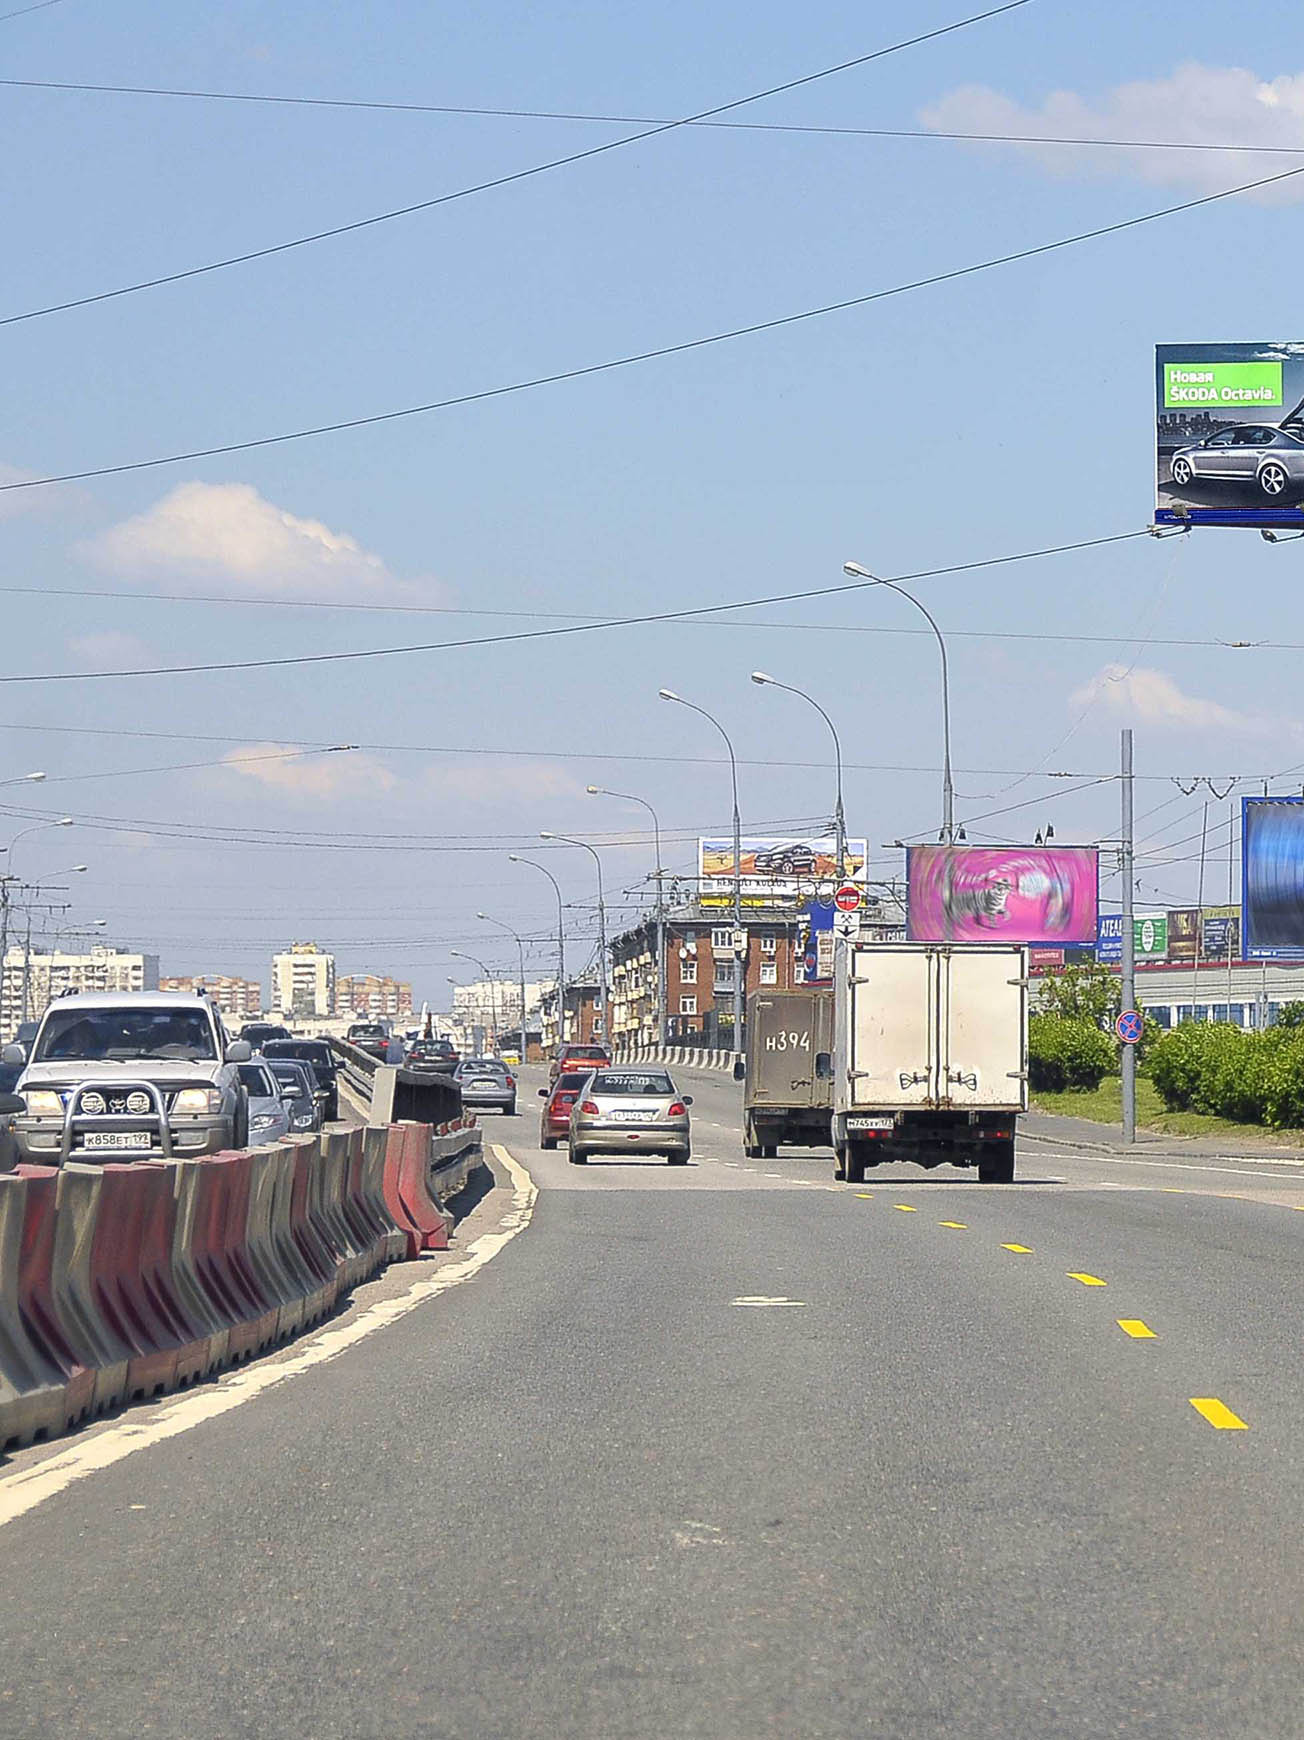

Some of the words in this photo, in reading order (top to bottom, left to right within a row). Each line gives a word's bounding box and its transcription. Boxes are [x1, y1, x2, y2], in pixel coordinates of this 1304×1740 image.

[1169, 369, 1214, 384] Новая
[1169, 385, 1218, 402] ŠKODA
[1221, 386, 1276, 401] Octavia.
[766, 1030, 810, 1052] Н394
